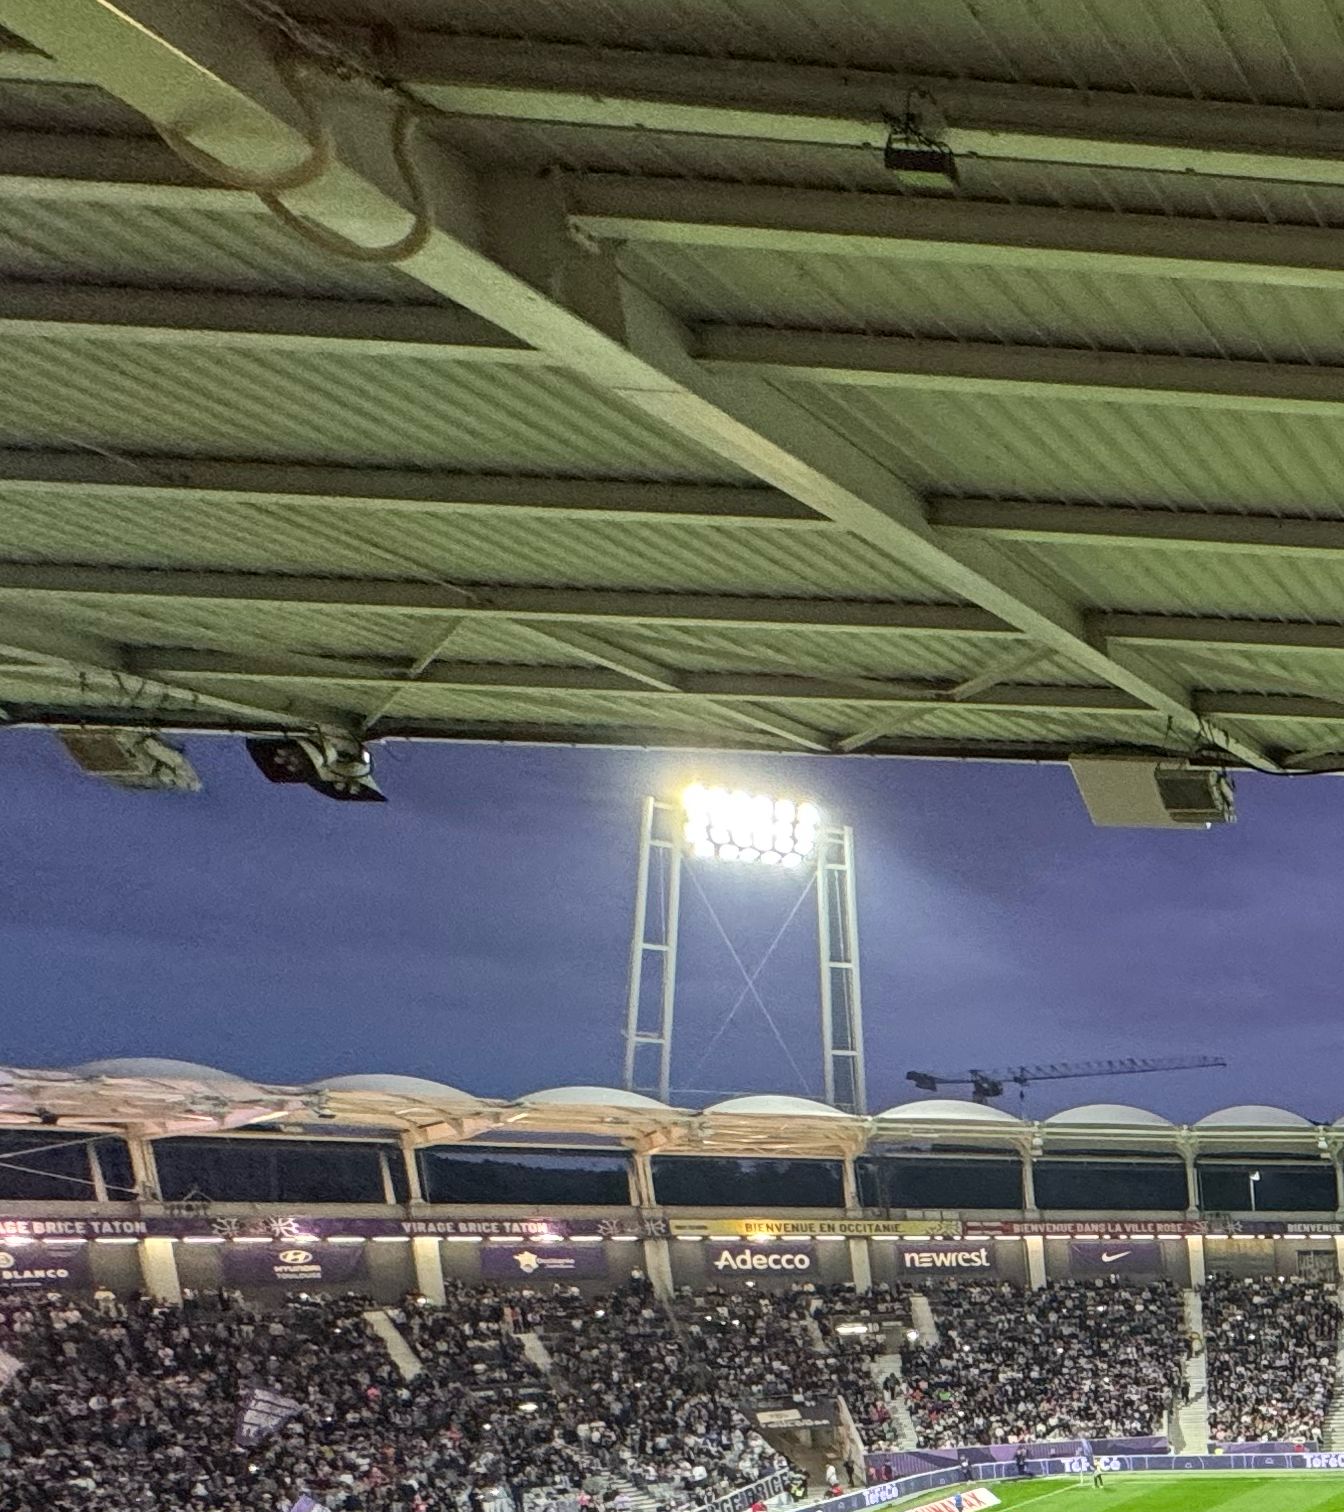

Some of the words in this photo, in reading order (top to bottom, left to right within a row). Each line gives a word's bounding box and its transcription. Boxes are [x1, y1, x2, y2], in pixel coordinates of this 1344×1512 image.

[32, 1221, 86, 1234] BRICE
[90, 1221, 147, 1234] TATON
[402, 1222, 457, 1234] VIRAGE
[459, 1222, 501, 1234] BRICE
[745, 1222, 816, 1234] BIENVENUE
[819, 1222, 835, 1234] EN
[838, 1222, 902, 1234] OCCITANIE
[1013, 1222, 1073, 1234] BIENVENUE
[1075, 1222, 1106, 1234] DANS
[1108, 1222, 1124, 1234] LA
[1126, 1222, 1156, 1234] VILLE
[1158, 1222, 1184, 1234] ROSE
[1287, 1223, 1337, 1233] BIENVENUE
[715, 1248, 811, 1271] Adecco
[2, 1268, 69, 1279] BLANCO
